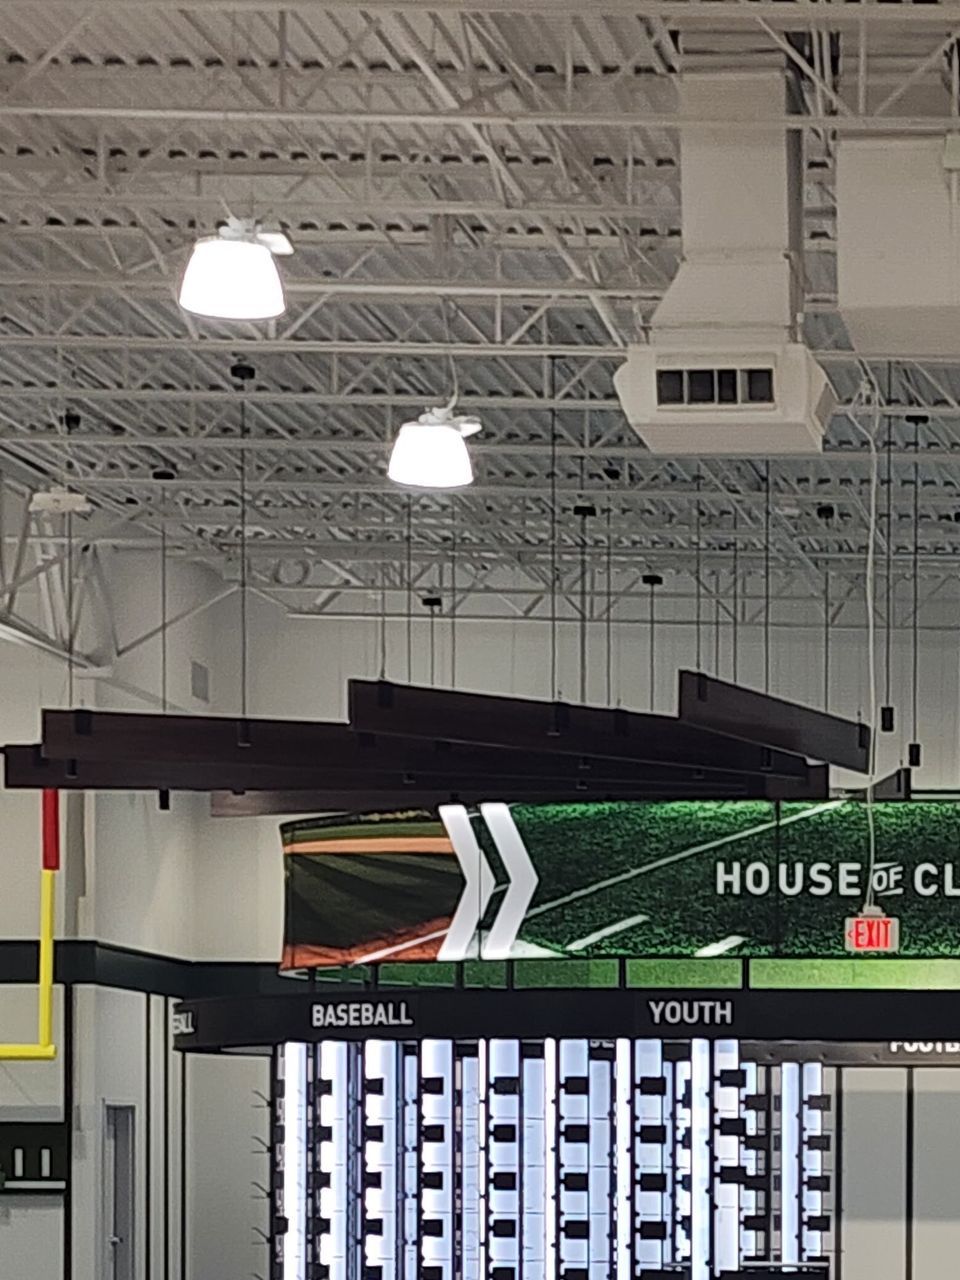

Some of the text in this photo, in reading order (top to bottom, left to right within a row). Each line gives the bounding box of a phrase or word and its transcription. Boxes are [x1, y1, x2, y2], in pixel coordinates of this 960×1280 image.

[716, 861, 862, 896] HOUSE
[872, 865, 904, 892] OF
[855, 920, 892, 949] EXIT
[312, 1002, 414, 1027] BASEBALL
[648, 1001, 733, 1024] YOUTH
